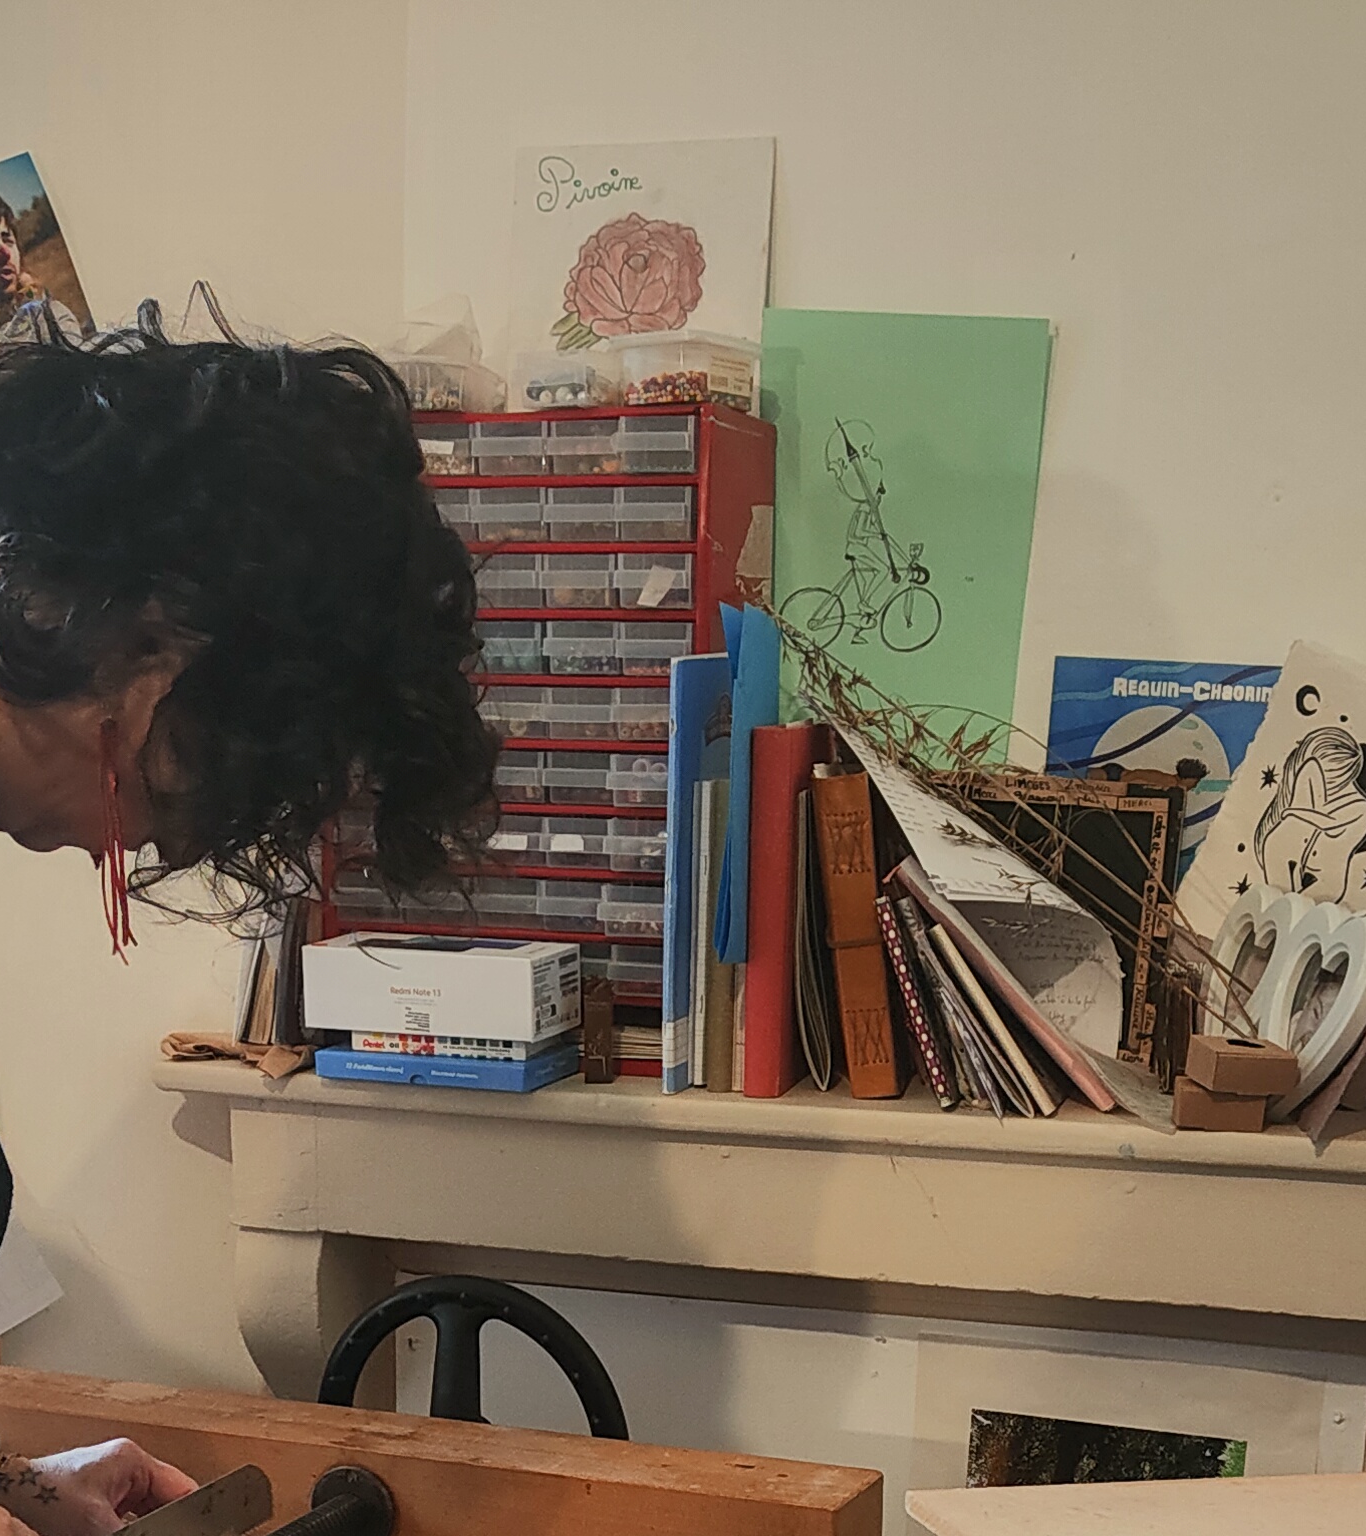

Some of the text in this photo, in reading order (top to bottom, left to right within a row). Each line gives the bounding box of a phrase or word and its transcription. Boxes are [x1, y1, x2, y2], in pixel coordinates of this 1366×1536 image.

[537, 156, 642, 212] Pivoine
[413, 988, 431, 997] Note
[363, 1038, 385, 1049] Pentel
